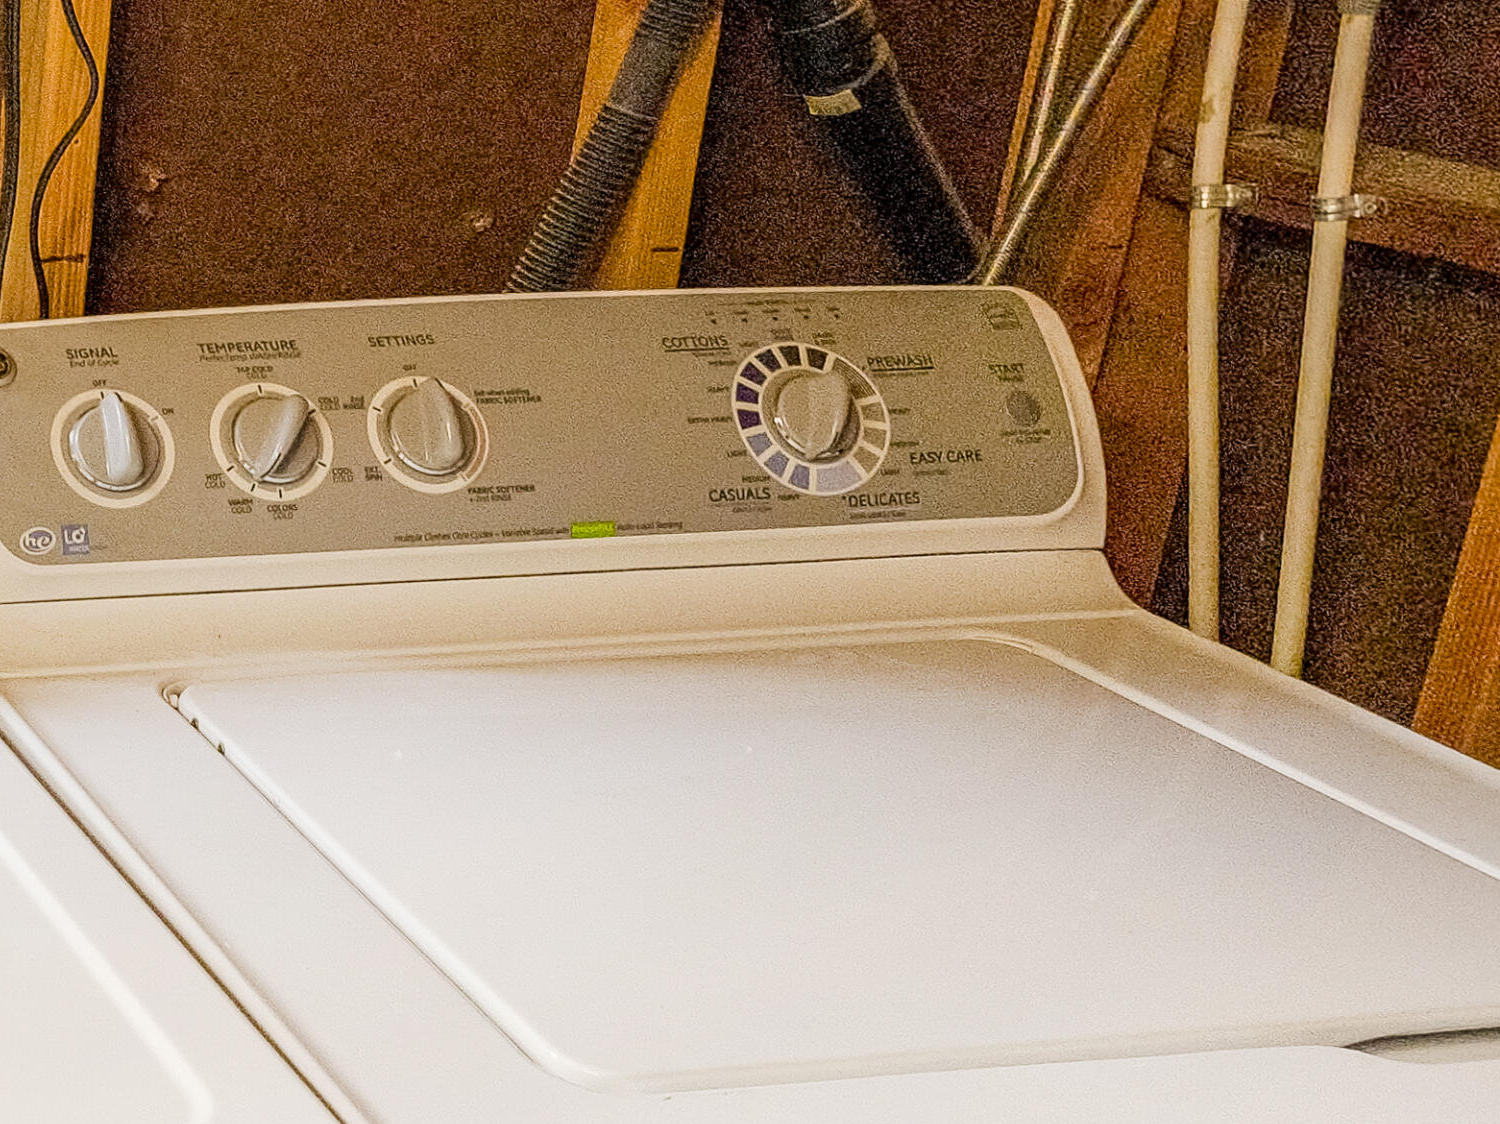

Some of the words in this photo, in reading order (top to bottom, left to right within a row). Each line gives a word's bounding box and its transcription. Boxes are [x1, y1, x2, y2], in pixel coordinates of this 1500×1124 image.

[197, 339, 299, 354] TEMPERATURE
[368, 335, 435, 348] SETTINGS
[662, 335, 728, 350] COTTONS
[66, 347, 118, 360] SIGNAL
[69, 360, 86, 368] End
[867, 354, 934, 368] PREWASH
[910, 451, 943, 465] EASY
[946, 449, 983, 463] CARE
[709, 487, 771, 502] CASUALS
